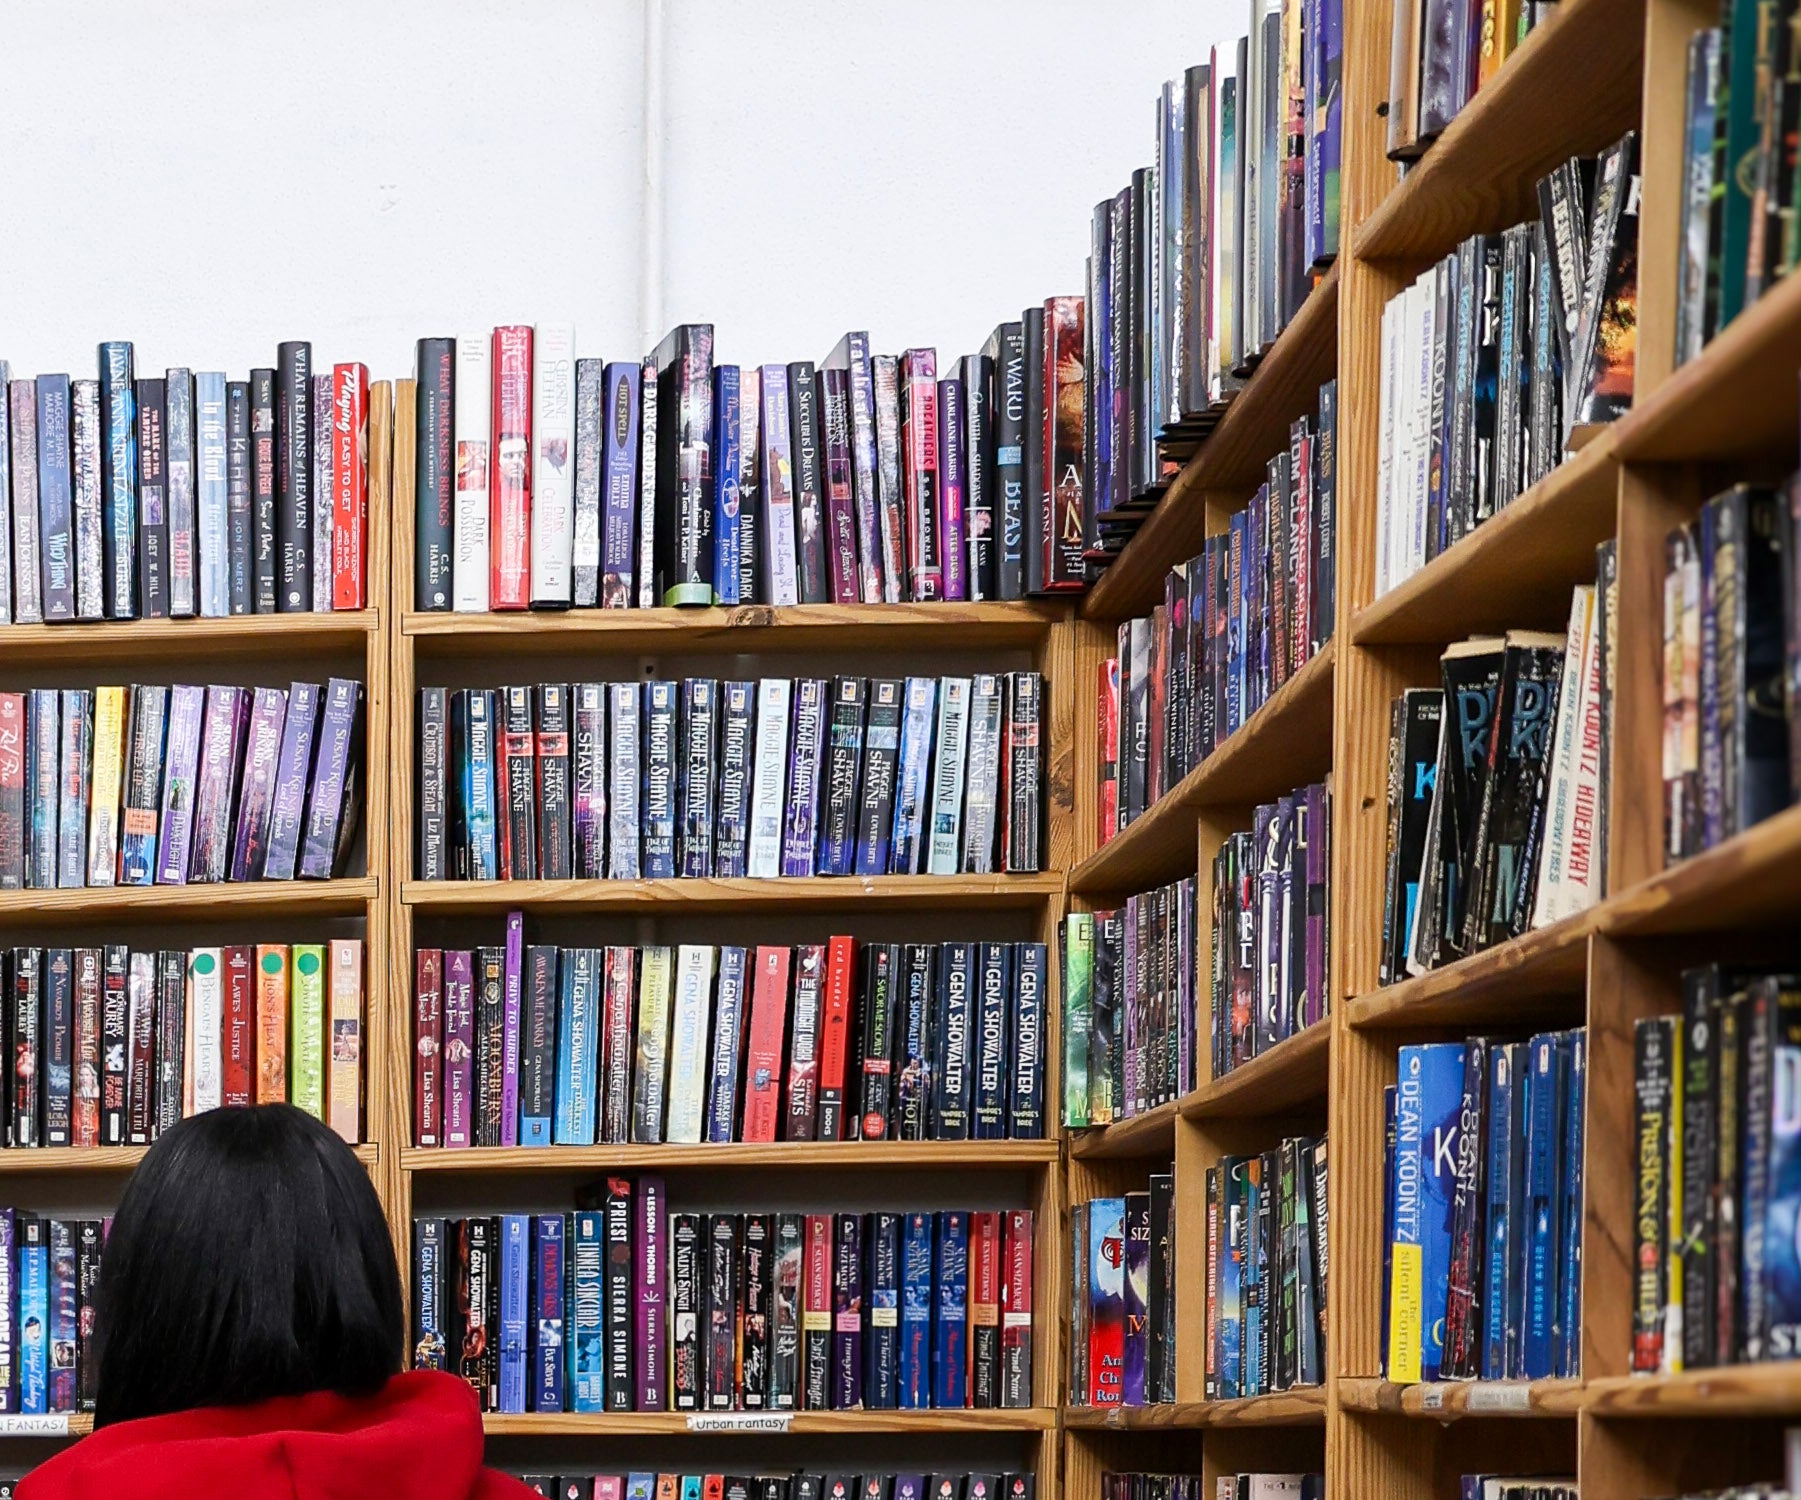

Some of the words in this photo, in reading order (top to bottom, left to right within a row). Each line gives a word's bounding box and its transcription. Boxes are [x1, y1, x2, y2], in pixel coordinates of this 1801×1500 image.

[294, 348, 307, 391] WHAT
[1006, 355, 1022, 422] WARD
[294, 394, 307, 461] REMAINS
[295, 470, 307, 529] HEAVEN
[740, 515, 753, 563] DANNIKA
[284, 542, 294, 584] HARRIS
[429, 544, 439, 584] HARRIS
[740, 566, 753, 600] DARK
[1567, 783, 1596, 887] HIDEAWAY
[947, 971, 966, 1010] GENA
[1019, 971, 1038, 1010] GENA
[945, 1013, 965, 1094] SHOWALTER
[1017, 1012, 1036, 1094] SHOWALTER
[792, 1079, 805, 1116] SIMS
[1399, 1080, 1419, 1144] DEAN
[1396, 1148, 1418, 1244] KOONTZ
[611, 1201, 627, 1243] PRIEST
[646, 1244, 656, 1285] THORNS
[675, 1246, 690, 1278] NALINI
[612, 1276, 627, 1324] SIERRA
[675, 1279, 690, 1311] SINGH
[613, 1331, 627, 1378] SIMONE
[7, 1418, 67, 1432] FANTASY
[696, 1416, 734, 1430] Urban
[738, 1416, 786, 1431] Fantasy
